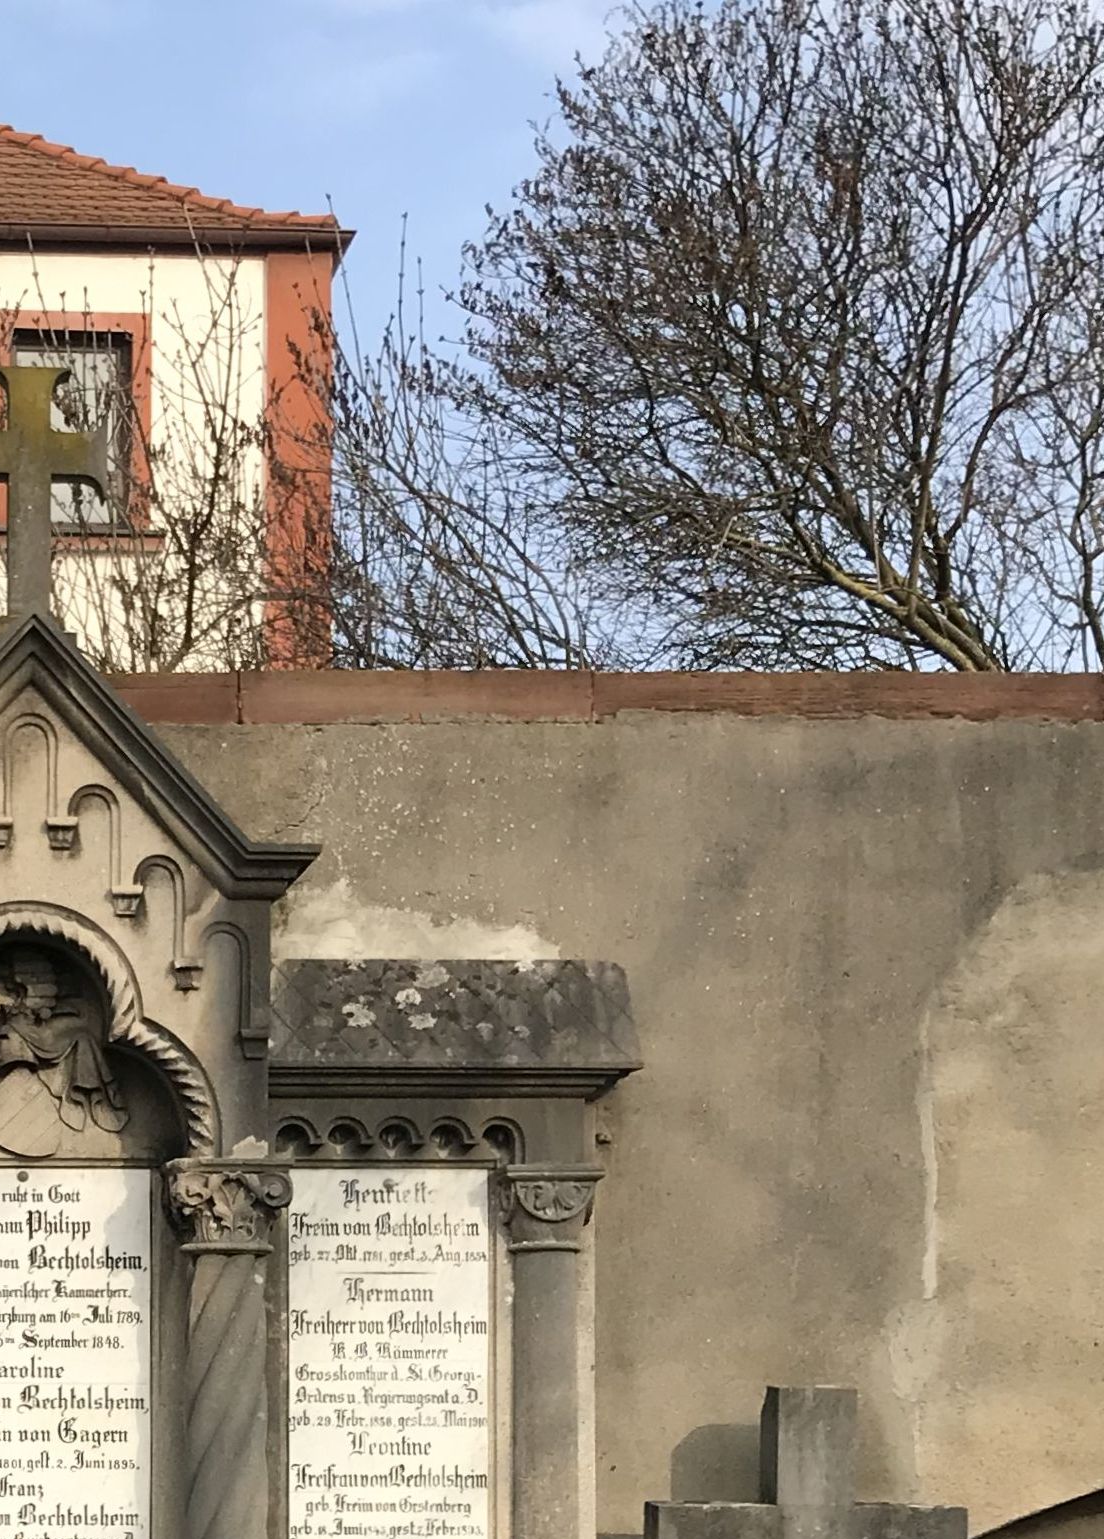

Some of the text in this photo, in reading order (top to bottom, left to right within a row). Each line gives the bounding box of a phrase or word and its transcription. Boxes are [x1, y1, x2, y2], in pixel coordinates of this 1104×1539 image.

[1, 1186, 28, 1207] ruht
[31, 1189, 43, 1203] in
[48, 1184, 81, 1204] Gott
[26, 1209, 91, 1240] Philipp
[290, 1212, 339, 1243] Freiin
[343, 1221, 372, 1237] von
[342, 1277, 434, 1310] Hermann
[39, 1313, 56, 1324] am
[82, 1305, 113, 1326] Juli
[290, 1309, 356, 1341] Freiherr
[357, 1320, 385, 1336] von
[18, 1330, 89, 1351] September
[296, 1386, 345, 1406] Ordens
[18, 1428, 51, 1443] von
[57, 1417, 128, 1449] Gagern
[347, 1431, 432, 1457] Leontine
[70, 1449, 106, 1472] Juni
[290, 1463, 358, 1492] Freifrau
[360, 1473, 388, 1489] von
[375, 1501, 397, 1513] von
